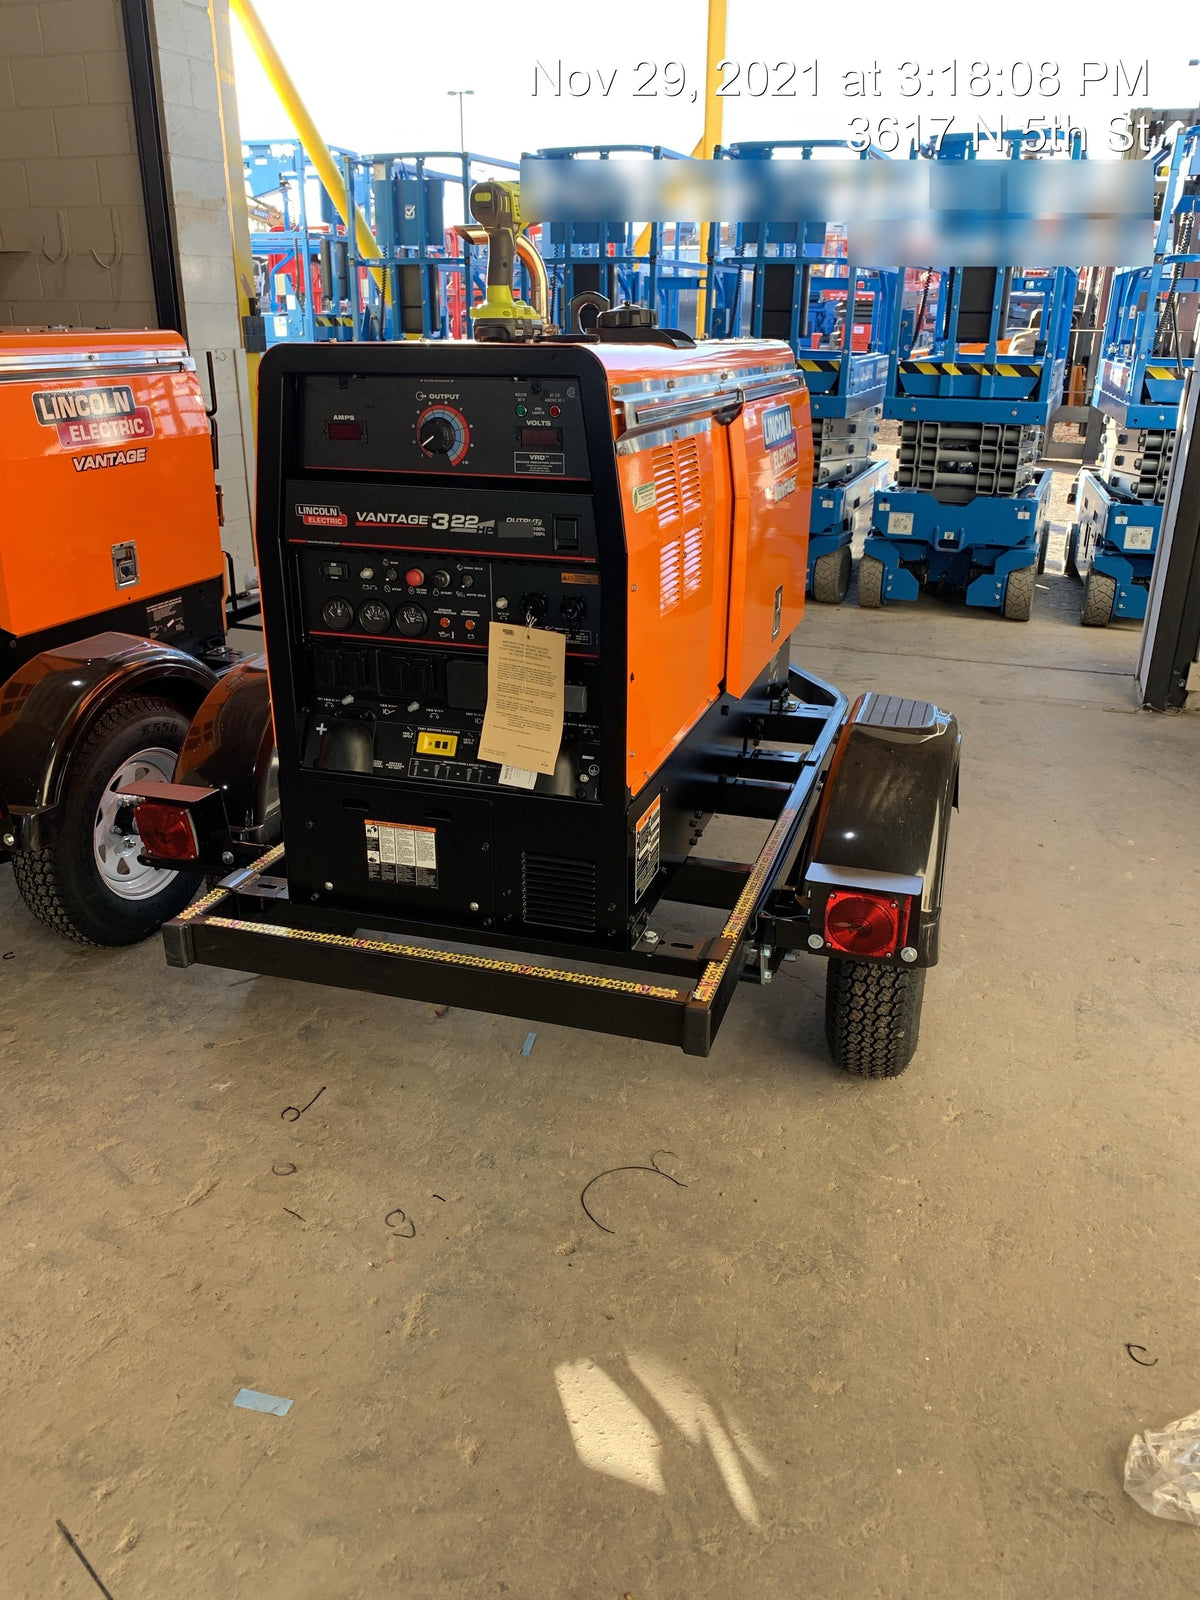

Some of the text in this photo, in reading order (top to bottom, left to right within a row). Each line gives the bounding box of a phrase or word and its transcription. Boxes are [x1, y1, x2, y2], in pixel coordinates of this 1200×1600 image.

[39, 391, 131, 420] LINCOLN
[69, 418, 145, 442] ELECTRIC
[764, 411, 791, 445] LINCOLN
[72, 448, 147, 471] VANTAGE
[773, 442, 796, 470] ELECTRIC
[298, 506, 337, 516] LINCOLN
[356, 512, 428, 525] VANTAGE
[431, 513, 479, 530] 322
[287, 929, 320, 939] STAND
[322, 935, 350, 944] HERE
[411, 948, 446, 958] TENEZ
[448, 955, 495, 967] DEBOUT
[571, 974, 600, 984] PARE
[606, 981, 635, 990] AQUI
